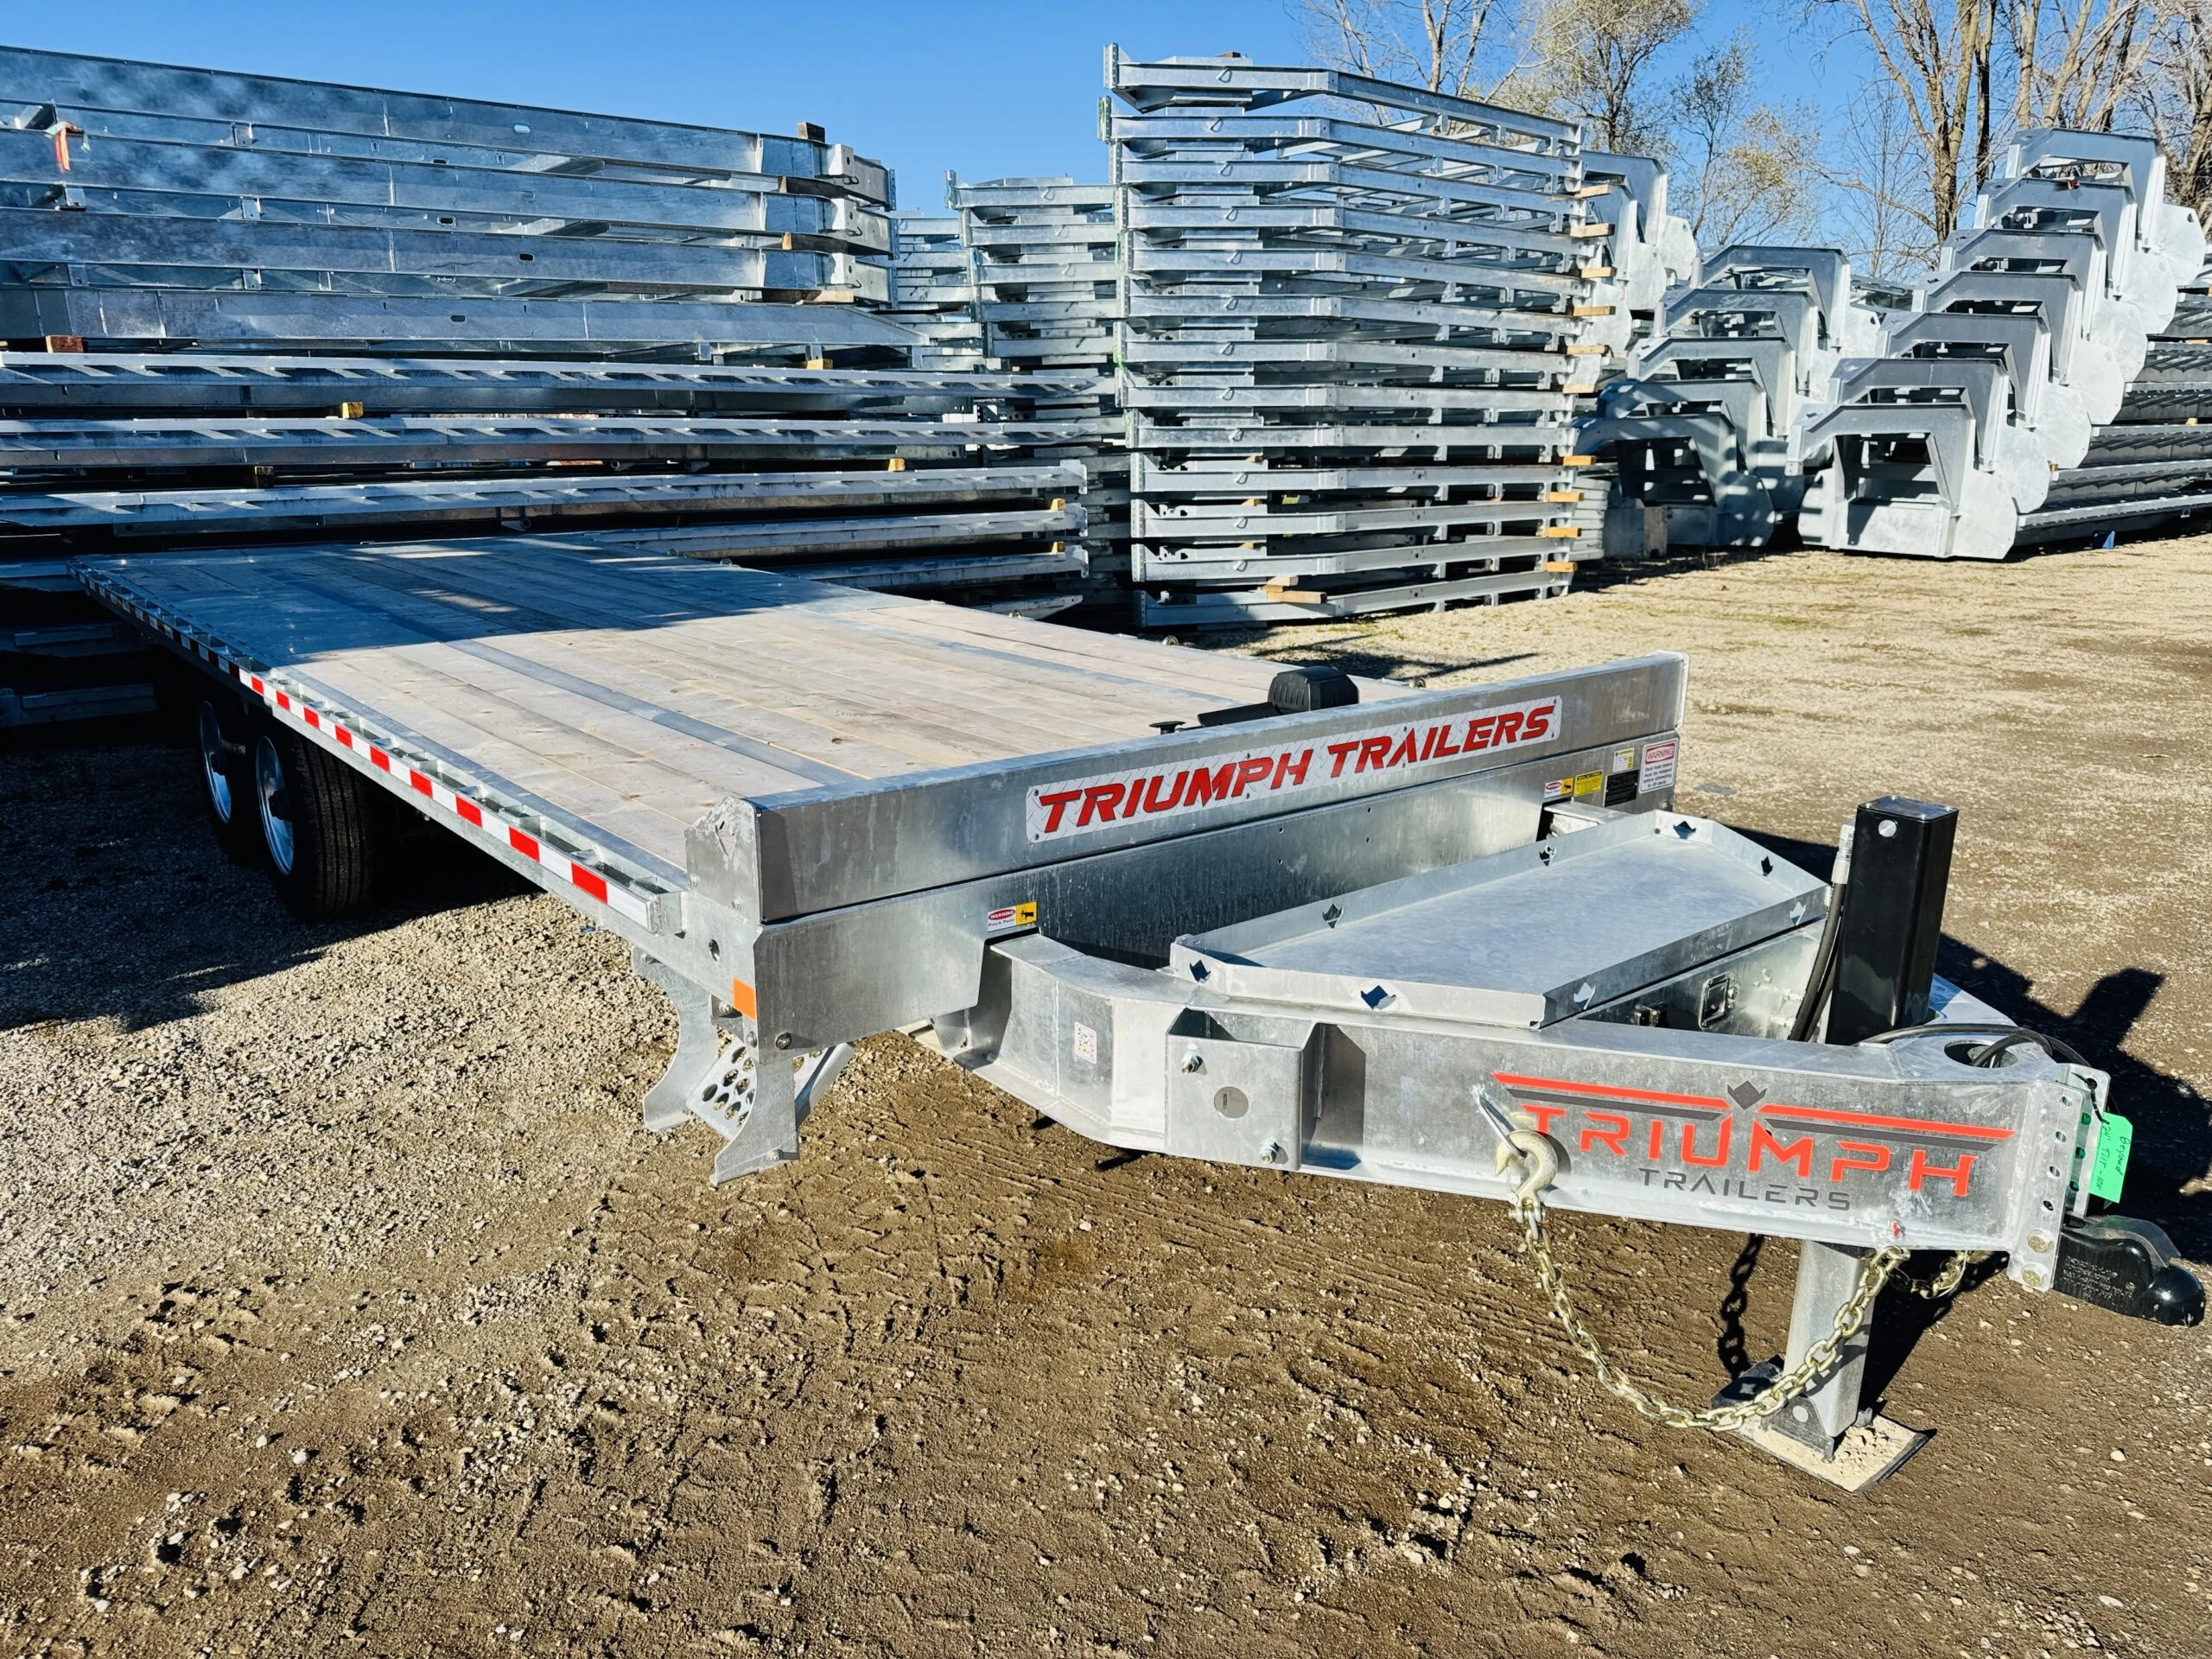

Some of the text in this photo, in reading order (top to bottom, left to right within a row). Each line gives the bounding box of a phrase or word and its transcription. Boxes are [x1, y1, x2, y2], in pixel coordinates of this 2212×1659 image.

[1039, 705, 1555, 833] TRIUMPH TRAILERS
[1647, 746, 1674, 760] WARNING
[990, 910, 1014, 919] WARNING
[1520, 1103, 1979, 1198] TRIUMPH
[2114, 1135, 2131, 1176] Beyond
[1638, 1167, 1851, 1211] TRAILERS
